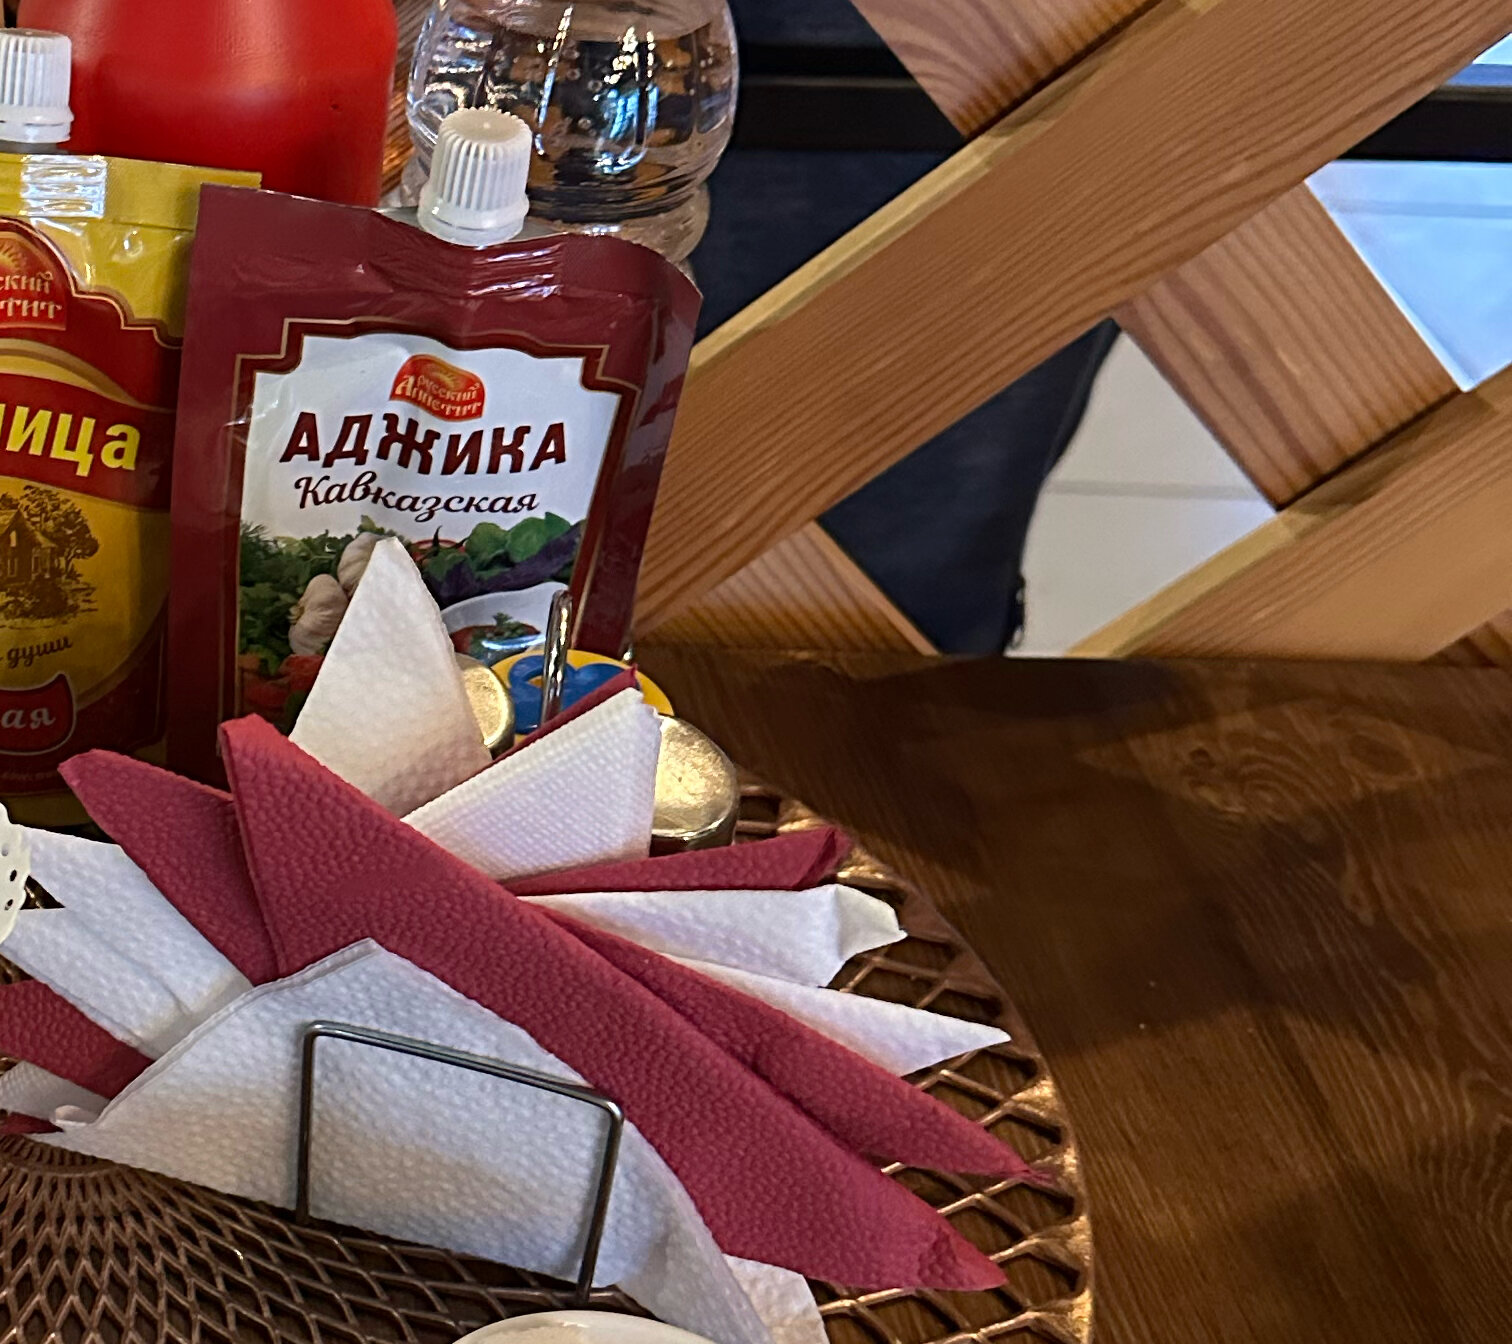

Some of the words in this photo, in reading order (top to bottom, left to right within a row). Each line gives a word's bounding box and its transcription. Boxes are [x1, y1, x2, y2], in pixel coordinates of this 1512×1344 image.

[280, 411, 567, 476] АДЖИКА
[294, 470, 540, 522] Кавказская
[6, 635, 73, 669] души
